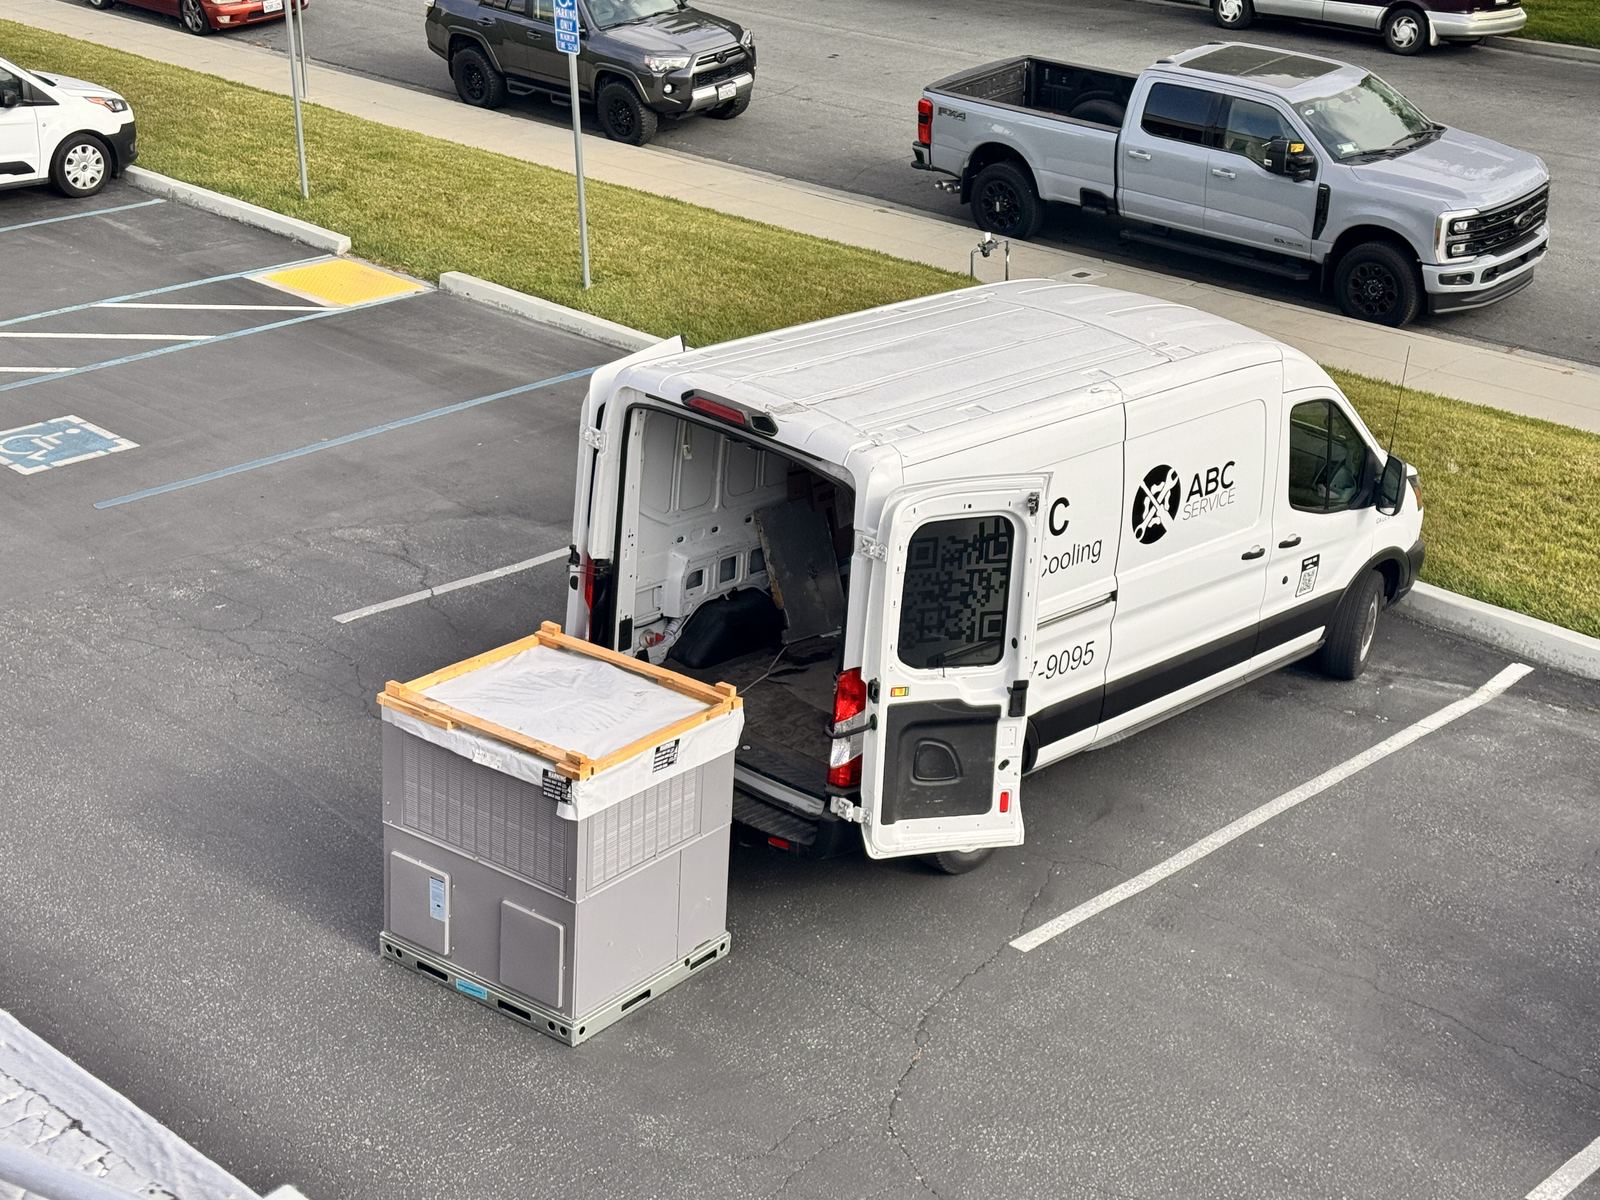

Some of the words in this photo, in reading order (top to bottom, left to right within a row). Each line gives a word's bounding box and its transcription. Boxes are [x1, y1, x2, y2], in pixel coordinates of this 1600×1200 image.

[556, 7, 577, 20] PARKING
[560, 19, 573, 31] ONLY
[1186, 461, 1235, 502] ABC
[1049, 497, 1070, 536] C
[1182, 487, 1236, 521] SERVICE
